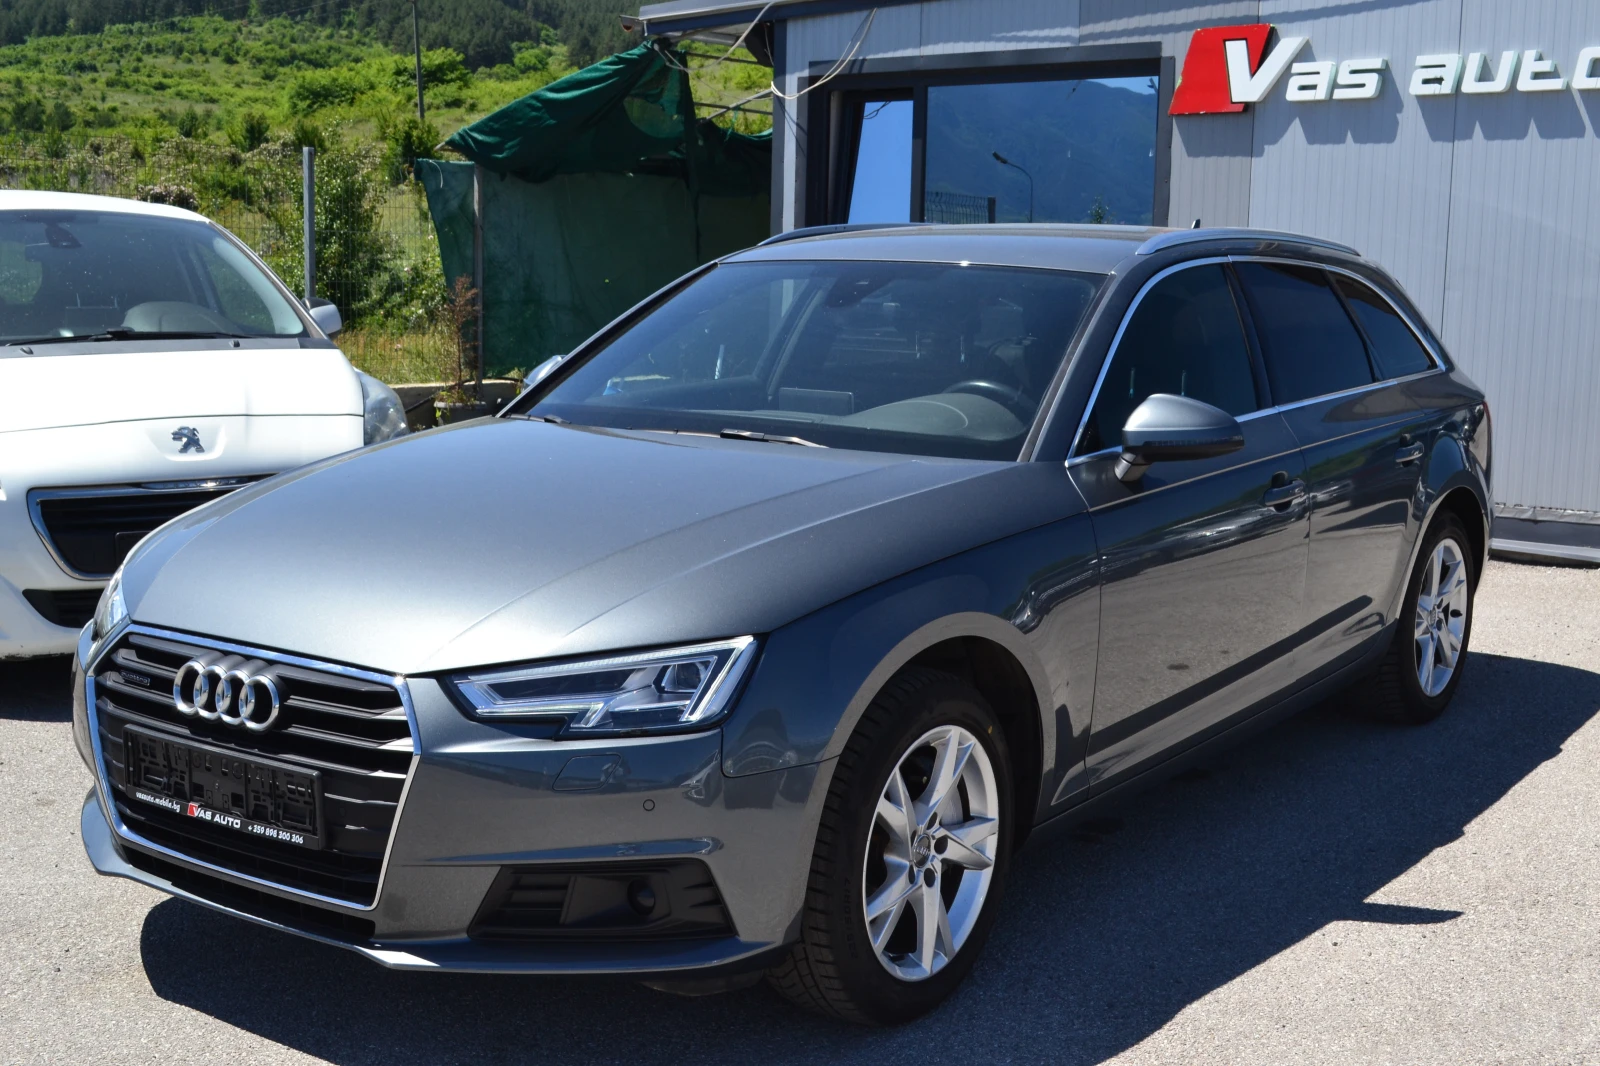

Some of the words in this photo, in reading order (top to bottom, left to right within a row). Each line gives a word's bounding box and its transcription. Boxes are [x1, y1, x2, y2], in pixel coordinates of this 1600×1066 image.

[1224, 36, 1387, 103] Vas
[135, 791, 181, 813] vasauto.mobile.bg
[193, 806, 212, 820] VAS
[213, 813, 241, 829] AUTO
[278, 831, 291, 841] 300
[291, 834, 304, 844] 306
